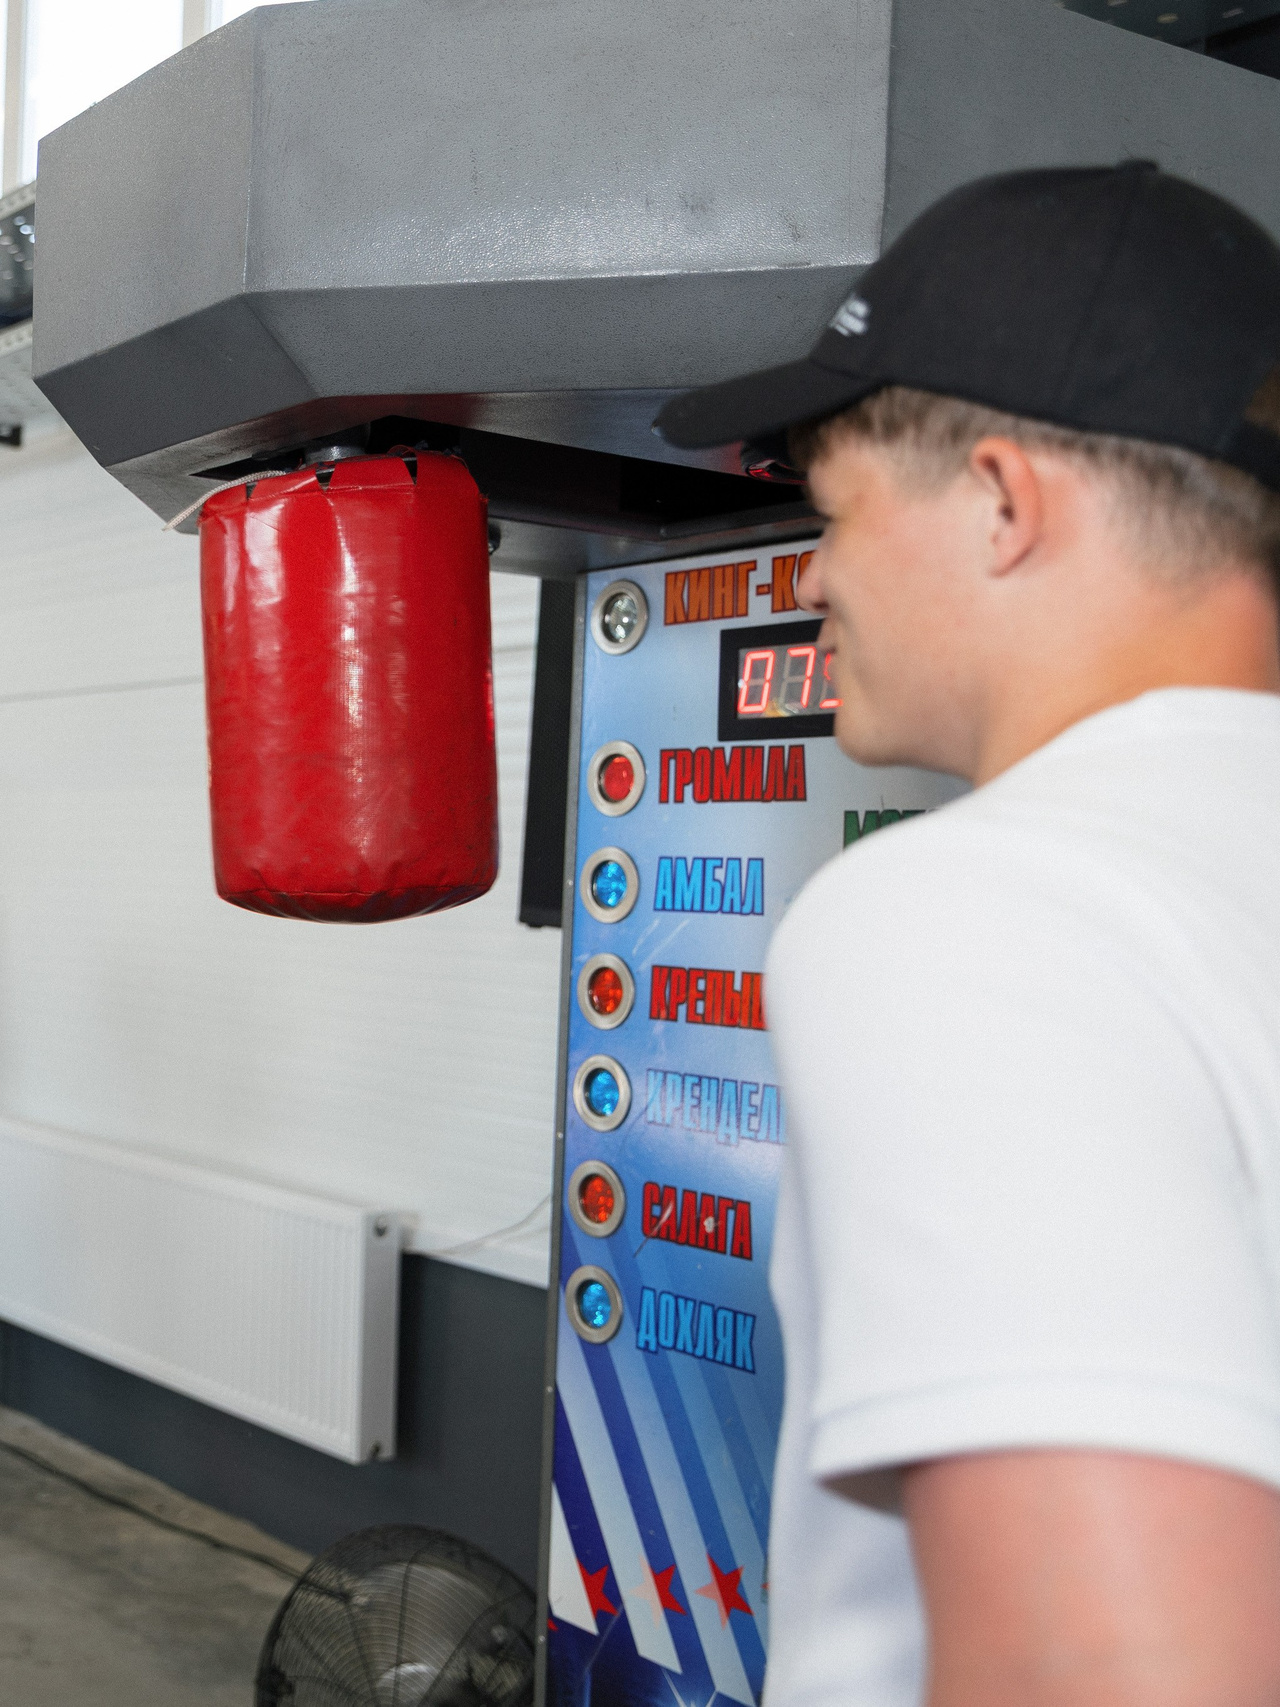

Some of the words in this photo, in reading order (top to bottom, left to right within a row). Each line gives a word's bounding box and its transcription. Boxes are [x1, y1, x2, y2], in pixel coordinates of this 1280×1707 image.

[659, 745, 807, 803] ГРОМИЛА
[653, 856, 764, 916] АМБАЛ
[646, 1068, 786, 1146] КРЕНДЕЛ
[642, 1181, 753, 1260] САЛАГА
[636, 1287, 756, 1374] ДОХЛЯК
